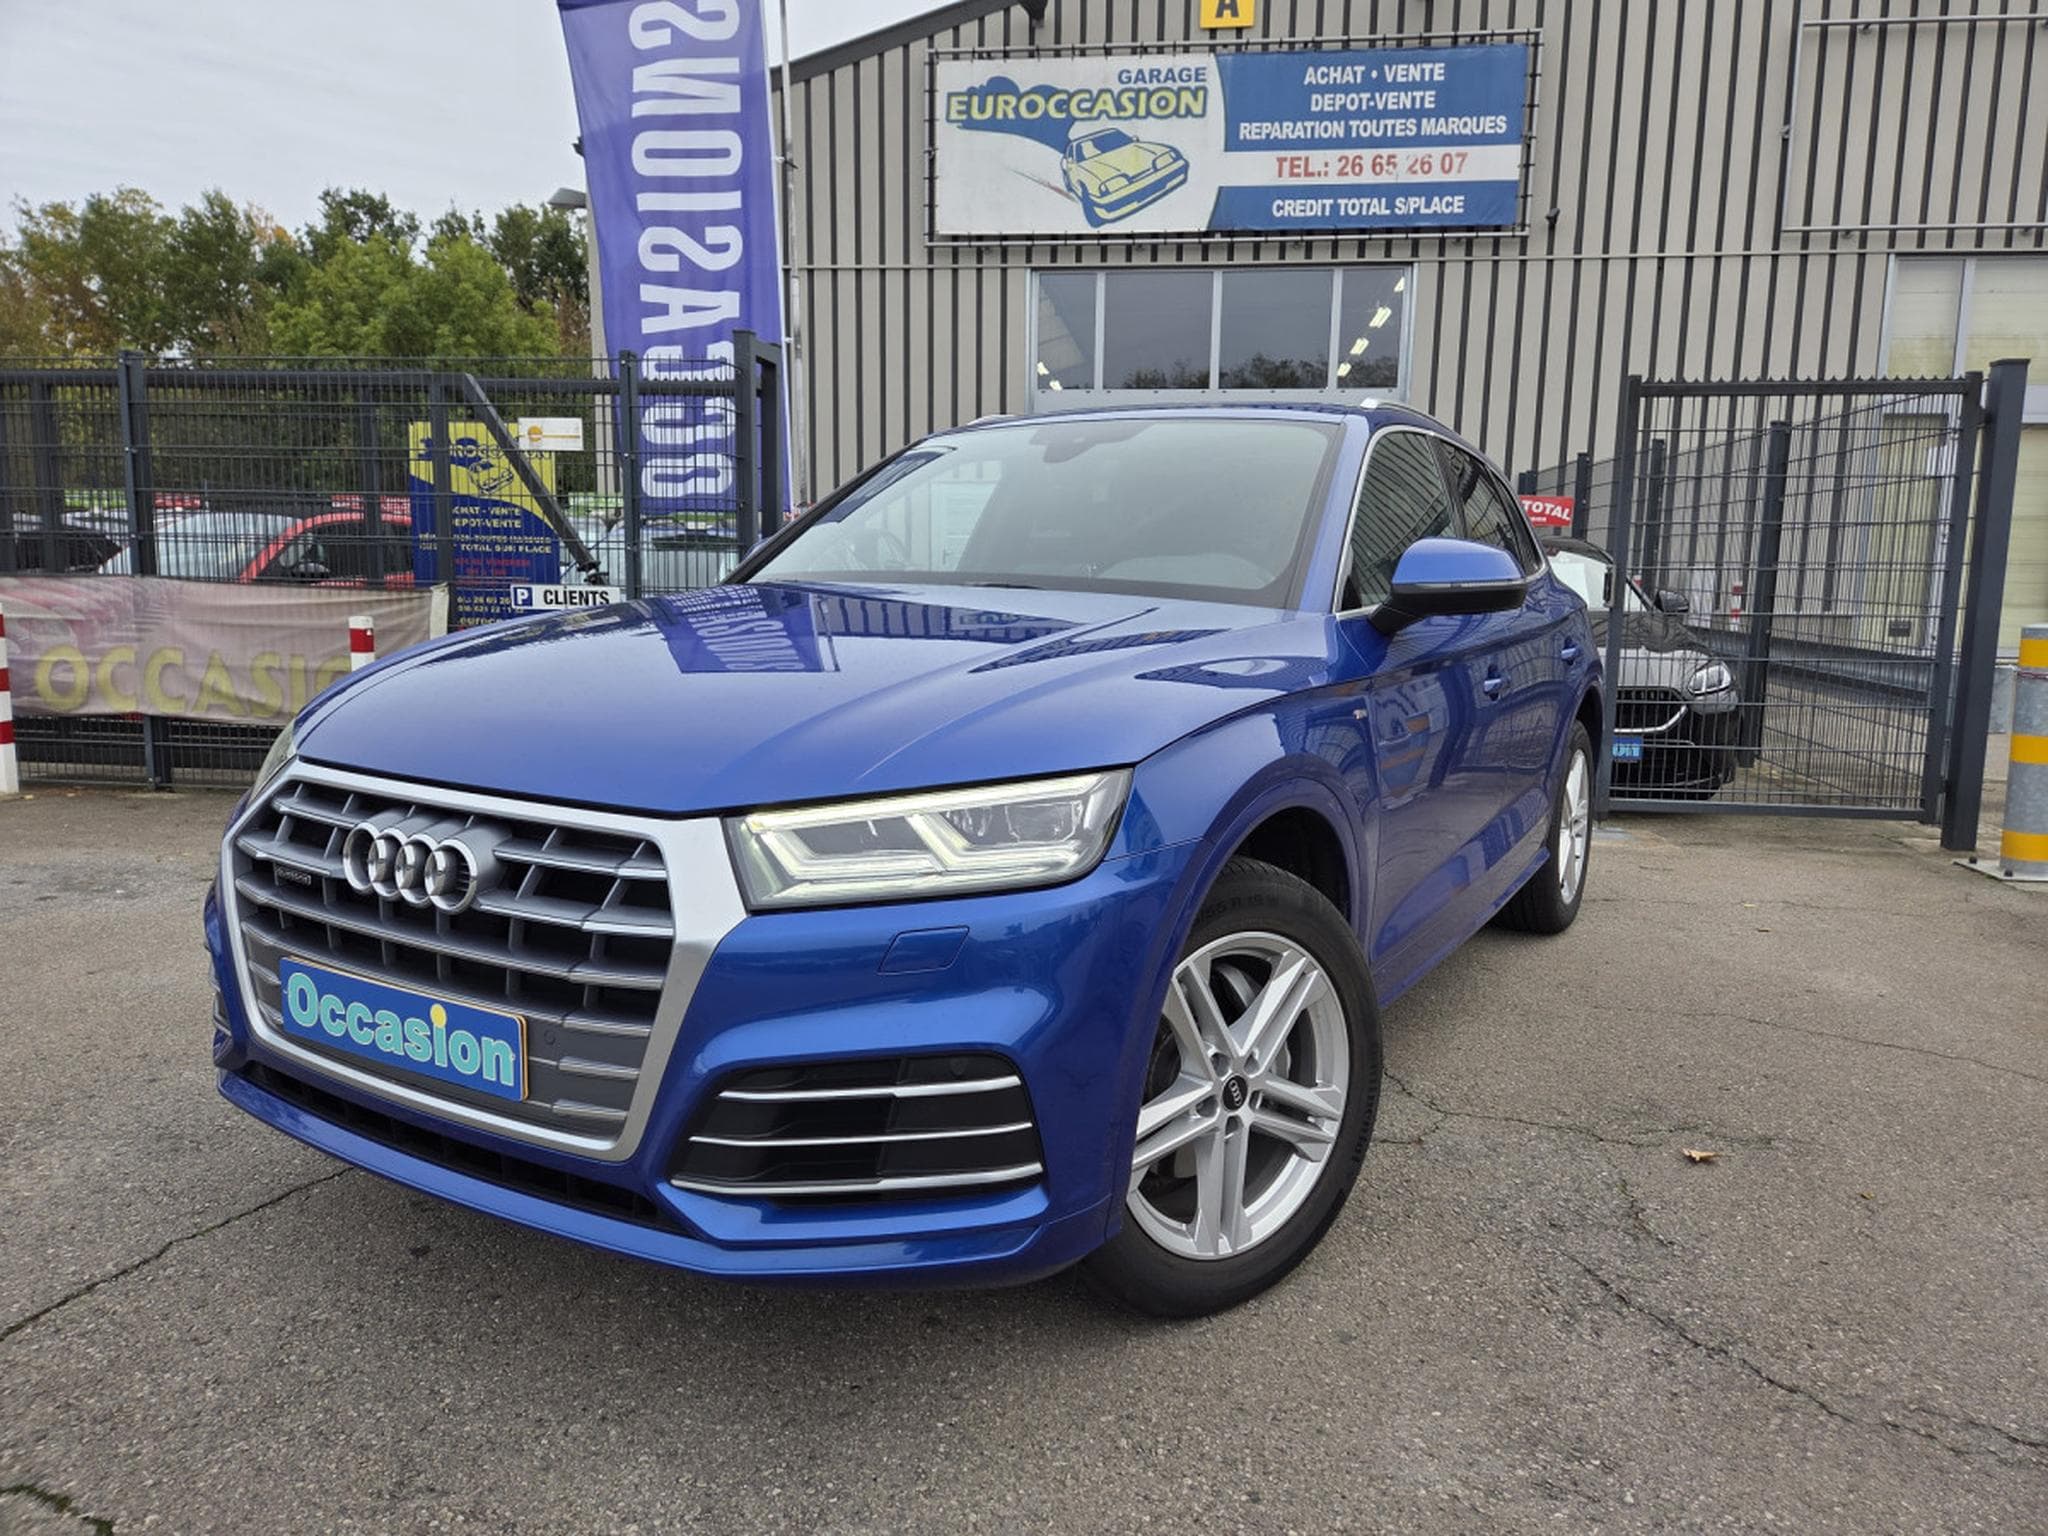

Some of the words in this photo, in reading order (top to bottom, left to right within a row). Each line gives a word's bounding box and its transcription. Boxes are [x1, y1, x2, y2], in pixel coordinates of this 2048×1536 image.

[1118, 67, 1207, 84] GARAGE
[1304, 65, 1365, 85] ACHAT
[1384, 62, 1446, 82] VENTE
[946, 86, 1209, 121] EUROCCASION
[1311, 91, 1436, 112] DEPOT-VENTE
[1239, 120, 1345, 140] REPARATION
[1348, 118, 1417, 137] TOUTES
[1421, 115, 1508, 136] MARQUES
[1276, 156, 1330, 178] TEL.:
[1337, 155, 1364, 177] 26
[1440, 152, 1469, 174] 07
[1272, 198, 1336, 218] CREDIT
[1337, 197, 1391, 215] TOTAL
[1395, 195, 1465, 215] S/PLACE
[1520, 499, 1571, 521] TOTAL
[452, 518, 522, 528] EPOT-VENTE
[516, 588, 530, 605] P
[543, 588, 610, 606] CLIENTS
[287, 972, 516, 1087] Occasion
